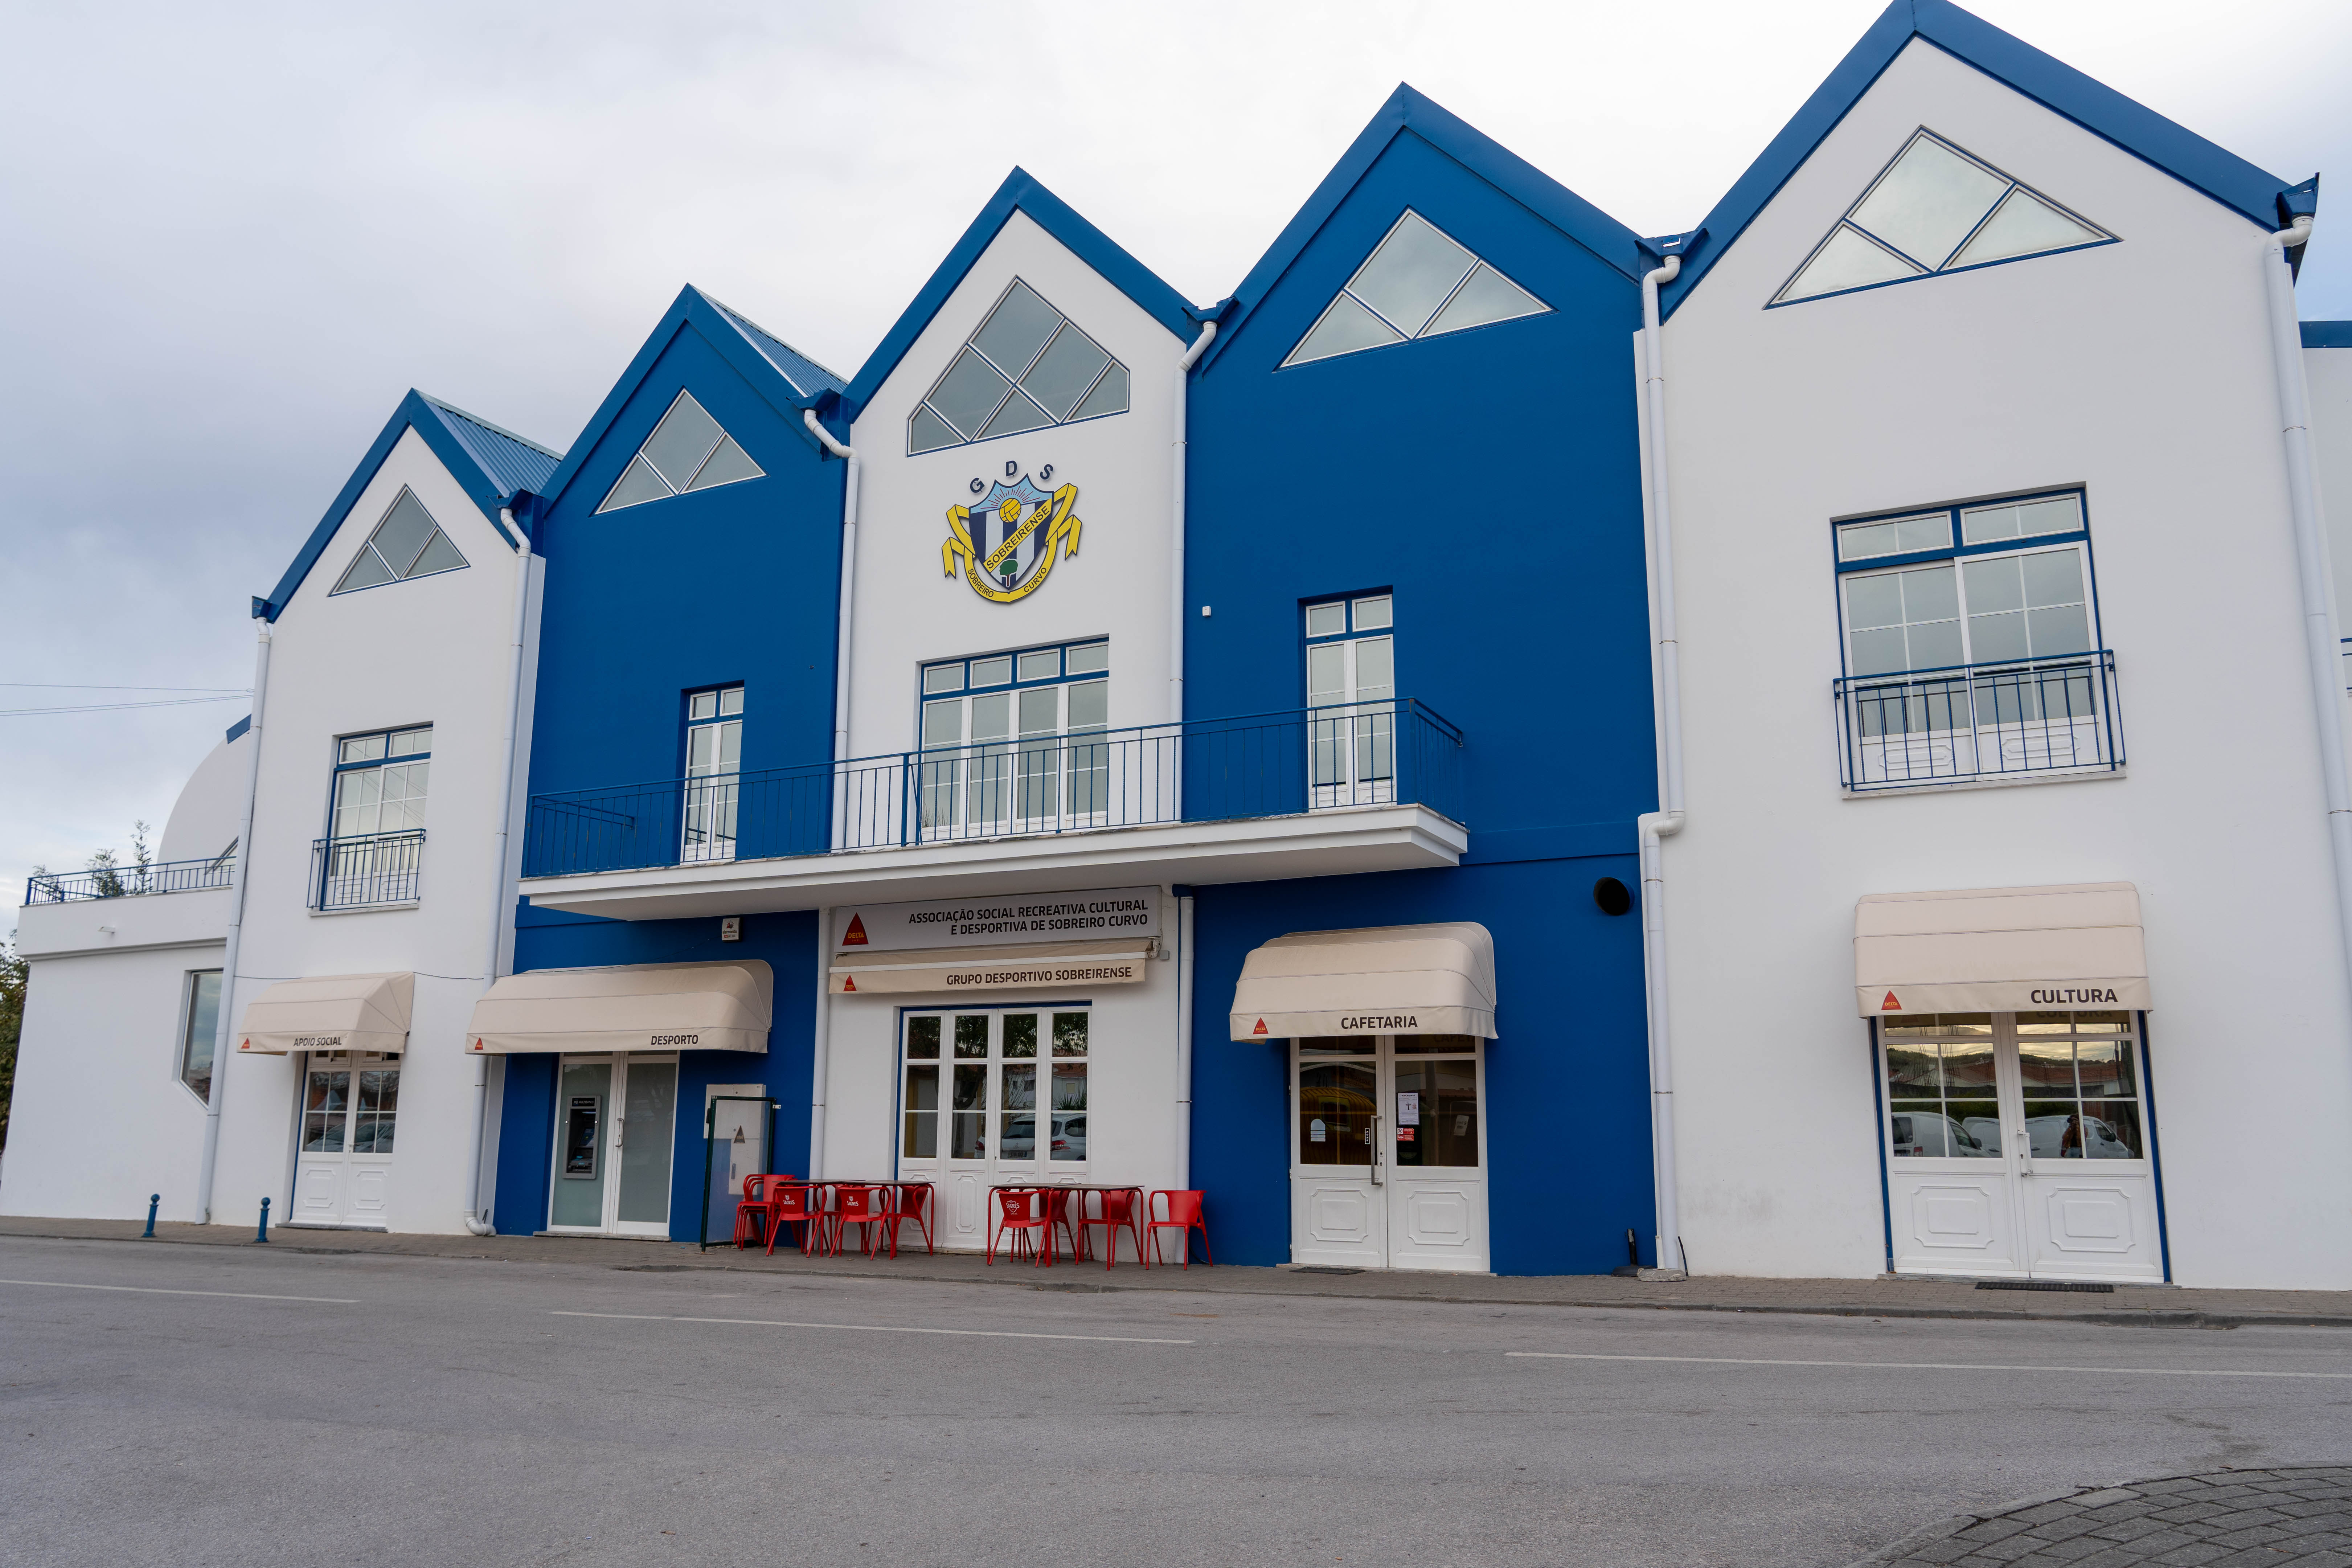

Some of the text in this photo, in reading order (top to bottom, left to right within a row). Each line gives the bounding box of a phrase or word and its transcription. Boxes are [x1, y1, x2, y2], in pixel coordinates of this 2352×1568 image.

[970, 460, 1053, 493] G D S
[987, 505, 1050, 569] SOBREIRENSE
[968, 567, 1047, 598] SOBREIRO CURVO
[909, 900, 1148, 924] ASSOCIAÇÃO SOCIAL RECREATIVA CULTURAL
[951, 914, 1148, 935] E DESPORTIVA DE SOBREIRO CURVO
[947, 967, 1132, 985] GRUPO DESPORTIVO SOBREIRENSE
[2031, 988, 2118, 1004] CULTURA
[1341, 1016, 1418, 1029] CAFETARIA
[293, 1037, 342, 1046] APOIO SOCIAL
[651, 1035, 698, 1045] DESPORTO
